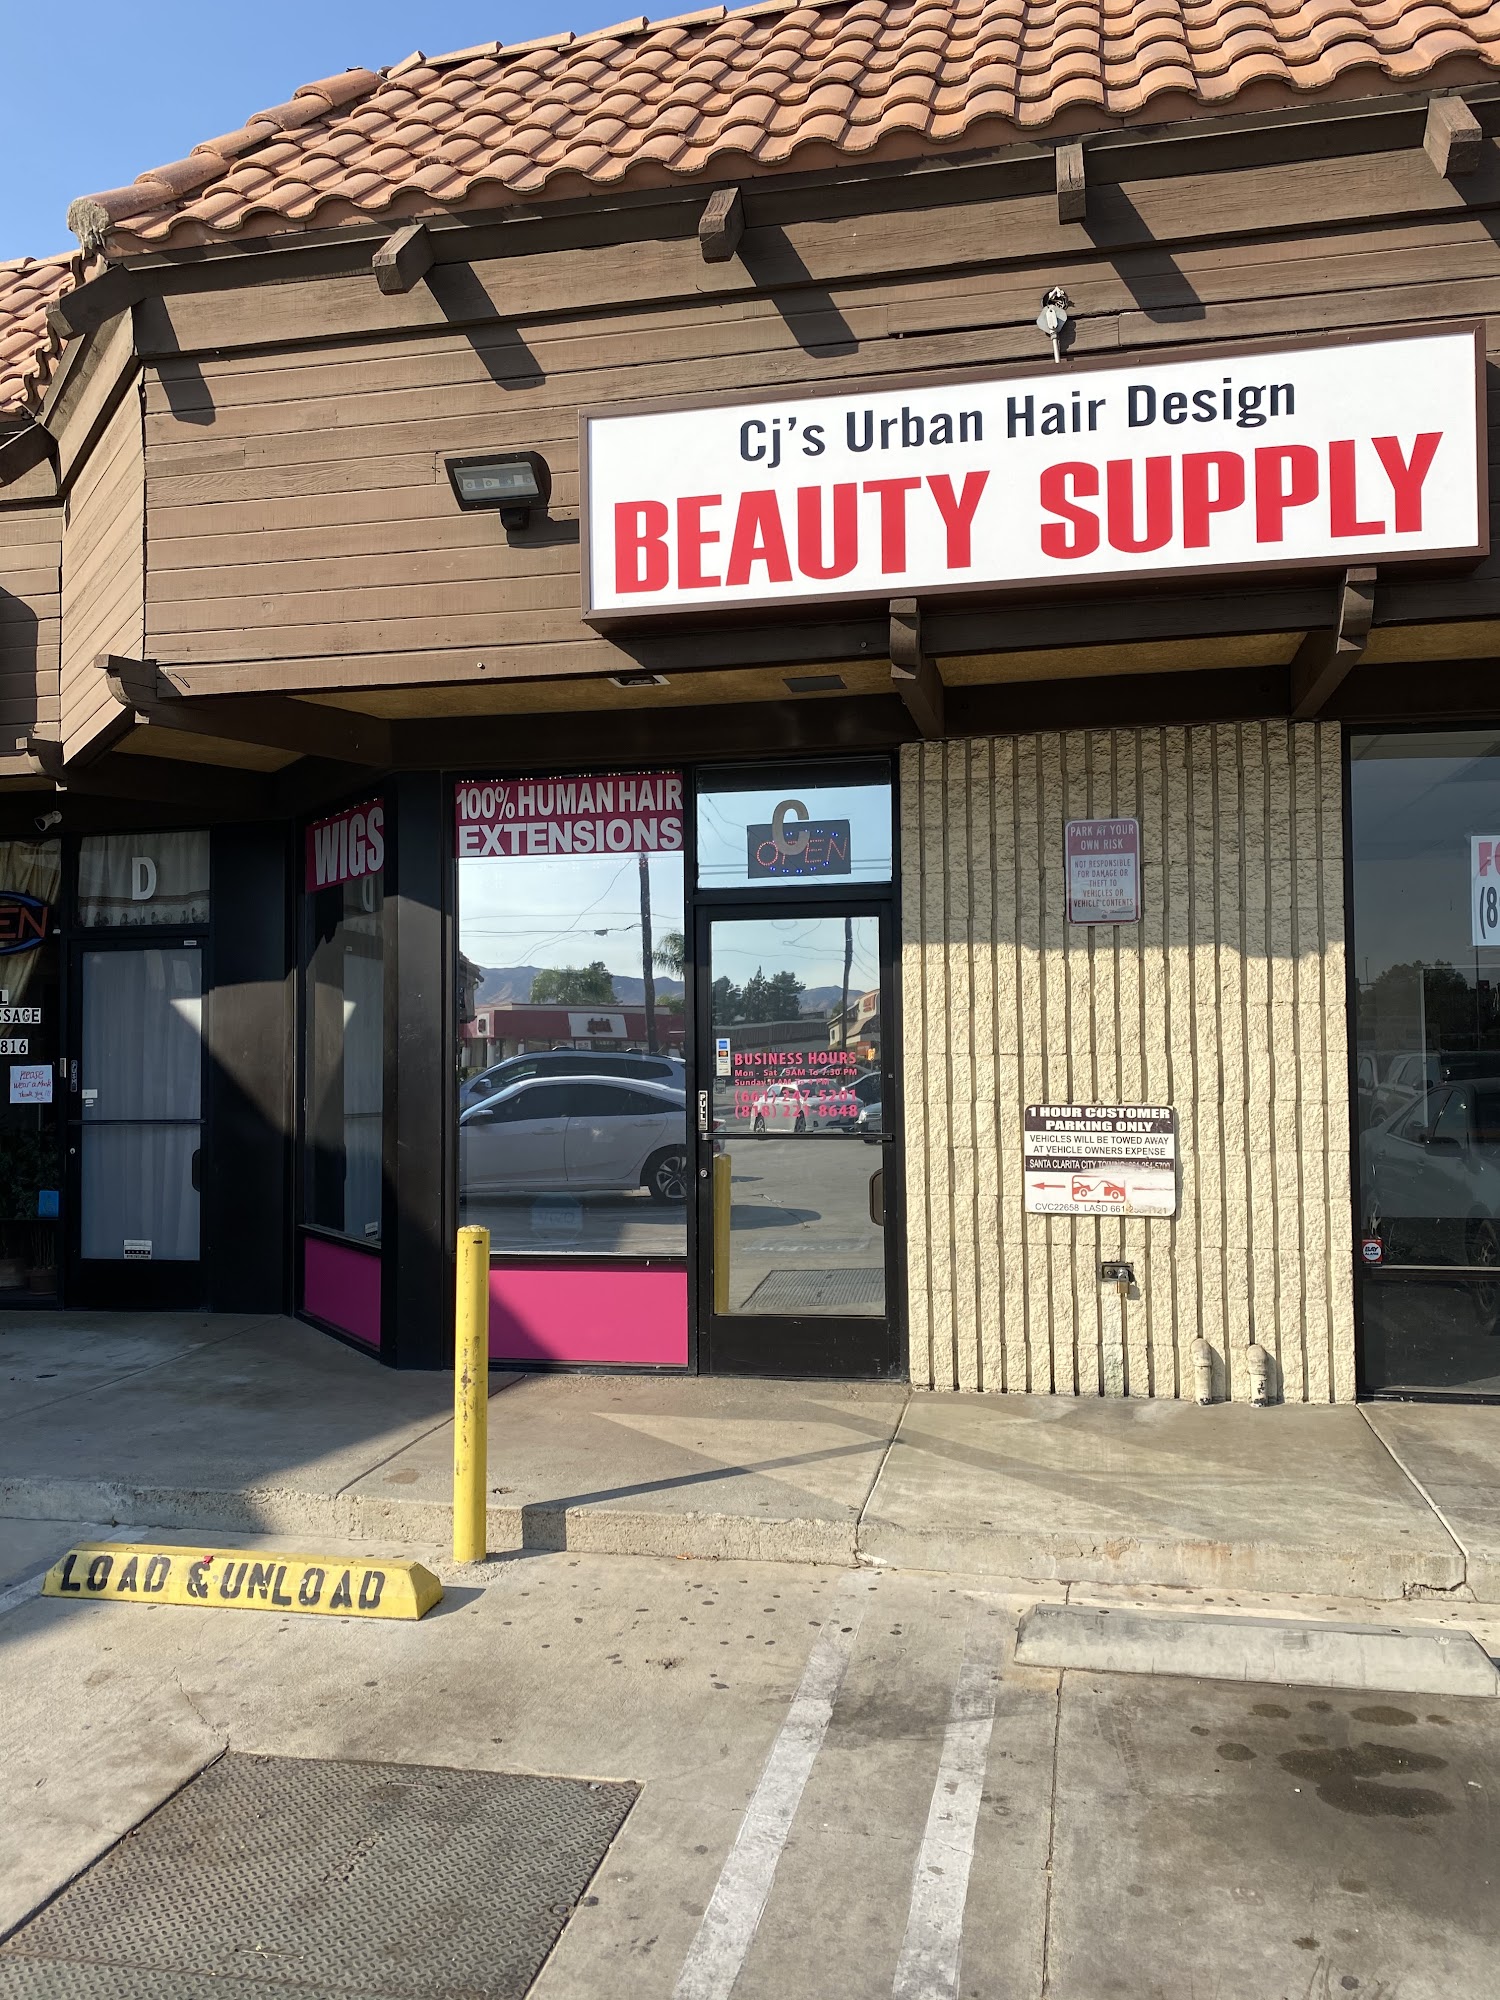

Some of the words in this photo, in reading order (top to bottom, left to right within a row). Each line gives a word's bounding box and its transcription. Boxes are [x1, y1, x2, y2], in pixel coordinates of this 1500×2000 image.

[740, 417, 826, 469] Cj's
[844, 407, 984, 455] Urban
[1006, 389, 1107, 438] Hair
[1128, 376, 1296, 427] Design
[614, 470, 991, 594] BEAUTY
[1038, 431, 1444, 560] SUPPLY
[456, 786, 516, 821] 100%
[517, 782, 616, 817] HUMAN
[618, 779, 683, 813] HAIR
[772, 799, 811, 856] C
[1070, 826, 1093, 837] PARK
[1110, 824, 1135, 835] YOUR
[459, 817, 683, 857] EXTENSIONS
[314, 805, 385, 886] WIGS
[1080, 839, 1099, 851] OWN
[1103, 838, 1124, 850] RISK
[1074, 860, 1087, 868] NOT
[1088, 859, 1131, 868] RESPONSIBLE
[131, 856, 158, 901] D
[1077, 870, 1090, 878] FOR
[1091, 869, 1118, 878] DAMAGE
[1119, 868, 1129, 877] OR
[1088, 879, 1107, 888] THEFT
[1110, 879, 1118, 887] TO
[1082, 889, 1113, 898] VEHICLES
[1114, 888, 1124, 897] OR
[1073, 899, 1099, 908] VEHICLE
[1101, 898, 1134, 907] CONTENTS
[1479, 886, 1500, 940] (8
[0, 1008, 40, 1023] SAGE
[734, 1052, 803, 1066] BUSINESS
[808, 1051, 857, 1065] HOURS
[734, 1069, 754, 1077] Mon
[763, 1069, 778, 1077] Sat
[785, 1068, 806, 1076] 9AM
[809, 1068, 819, 1076] To
[822, 1068, 841, 1076] 7:30
[843, 1067, 858, 1076] PM
[734, 1079, 766, 1087] Sunday
[777, 1078, 792, 1086] AM
[734, 1090, 776, 1103] (661)
[734, 1104, 777, 1119] (818)
[782, 1104, 859, 1118] 221-8648
[1029, 1107, 1037, 1117] 1
[1040, 1107, 1082, 1118] HOUR
[1086, 1108, 1170, 1119] CUSTOMER
[1045, 1120, 1112, 1132] PARKING
[1116, 1121, 1154, 1132] ONLY
[1030, 1134, 1072, 1143] VEHICLES
[1074, 1135, 1094, 1144] WILL
[1096, 1135, 1109, 1144] BE
[1111, 1136, 1142, 1145] TOWED
[1144, 1137, 1169, 1145] AWAY
[1033, 1145, 1045, 1153] AT
[1046, 1145, 1083, 1154] VEHICLE
[1084, 1146, 1123, 1155] OWNERS
[1125, 1147, 1166, 1156] EXPENSE
[1029, 1158, 1051, 1169] SANTA
[1052, 1159, 1080, 1169] CLARITA
[1081, 1160, 1097, 1169] CITY
[1035, 1203, 1080, 1212] CVC22658
[1083, 1204, 1108, 1213] LASD
[60, 1553, 171, 1592] LOAD
[187, 1560, 209, 1599] &
[219, 1562, 386, 1610] UNLOAD
